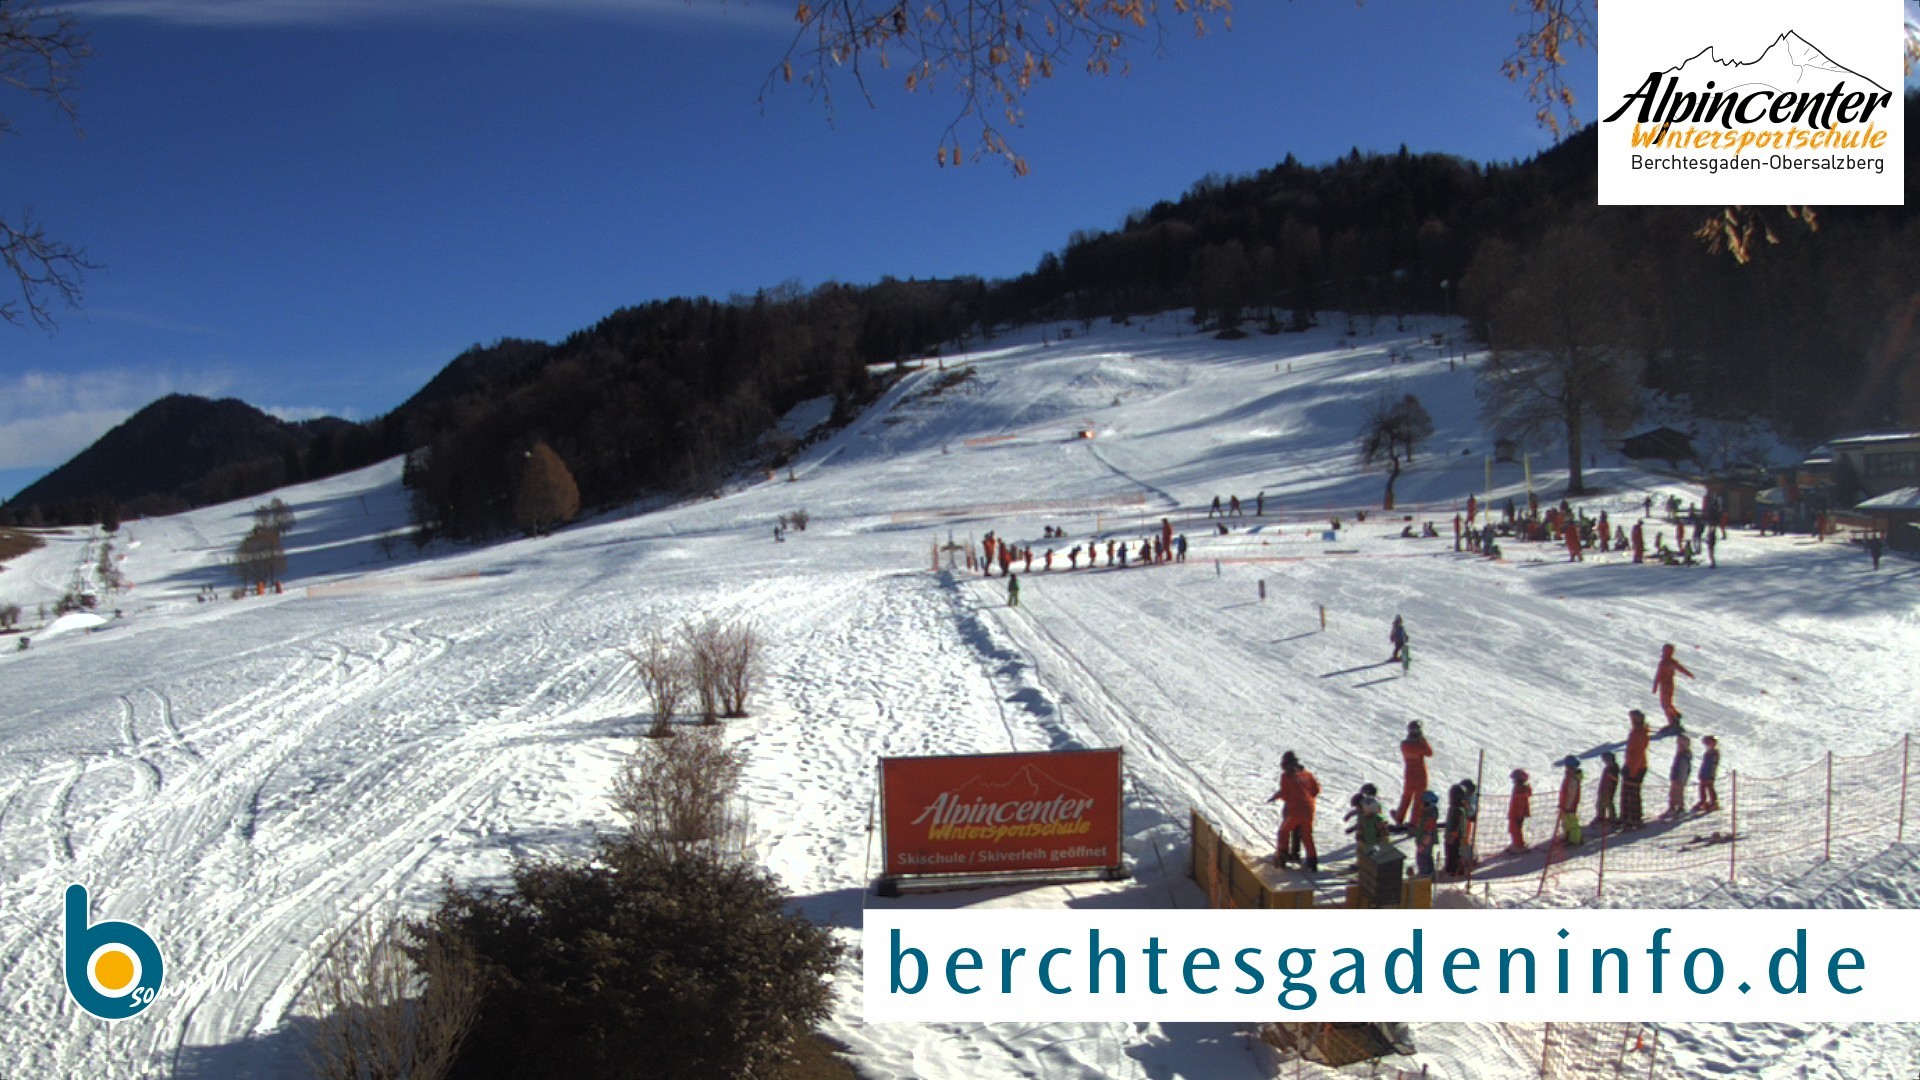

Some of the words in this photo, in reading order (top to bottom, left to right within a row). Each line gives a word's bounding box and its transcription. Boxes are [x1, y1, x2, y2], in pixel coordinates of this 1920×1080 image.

[911, 791, 1094, 826] Alpincenter
[928, 817, 1092, 843] Wintersportschule
[897, 851, 966, 865] Skischule
[978, 848, 1046, 862] Skiverleih
[1050, 845, 1108, 862] geöffnet
